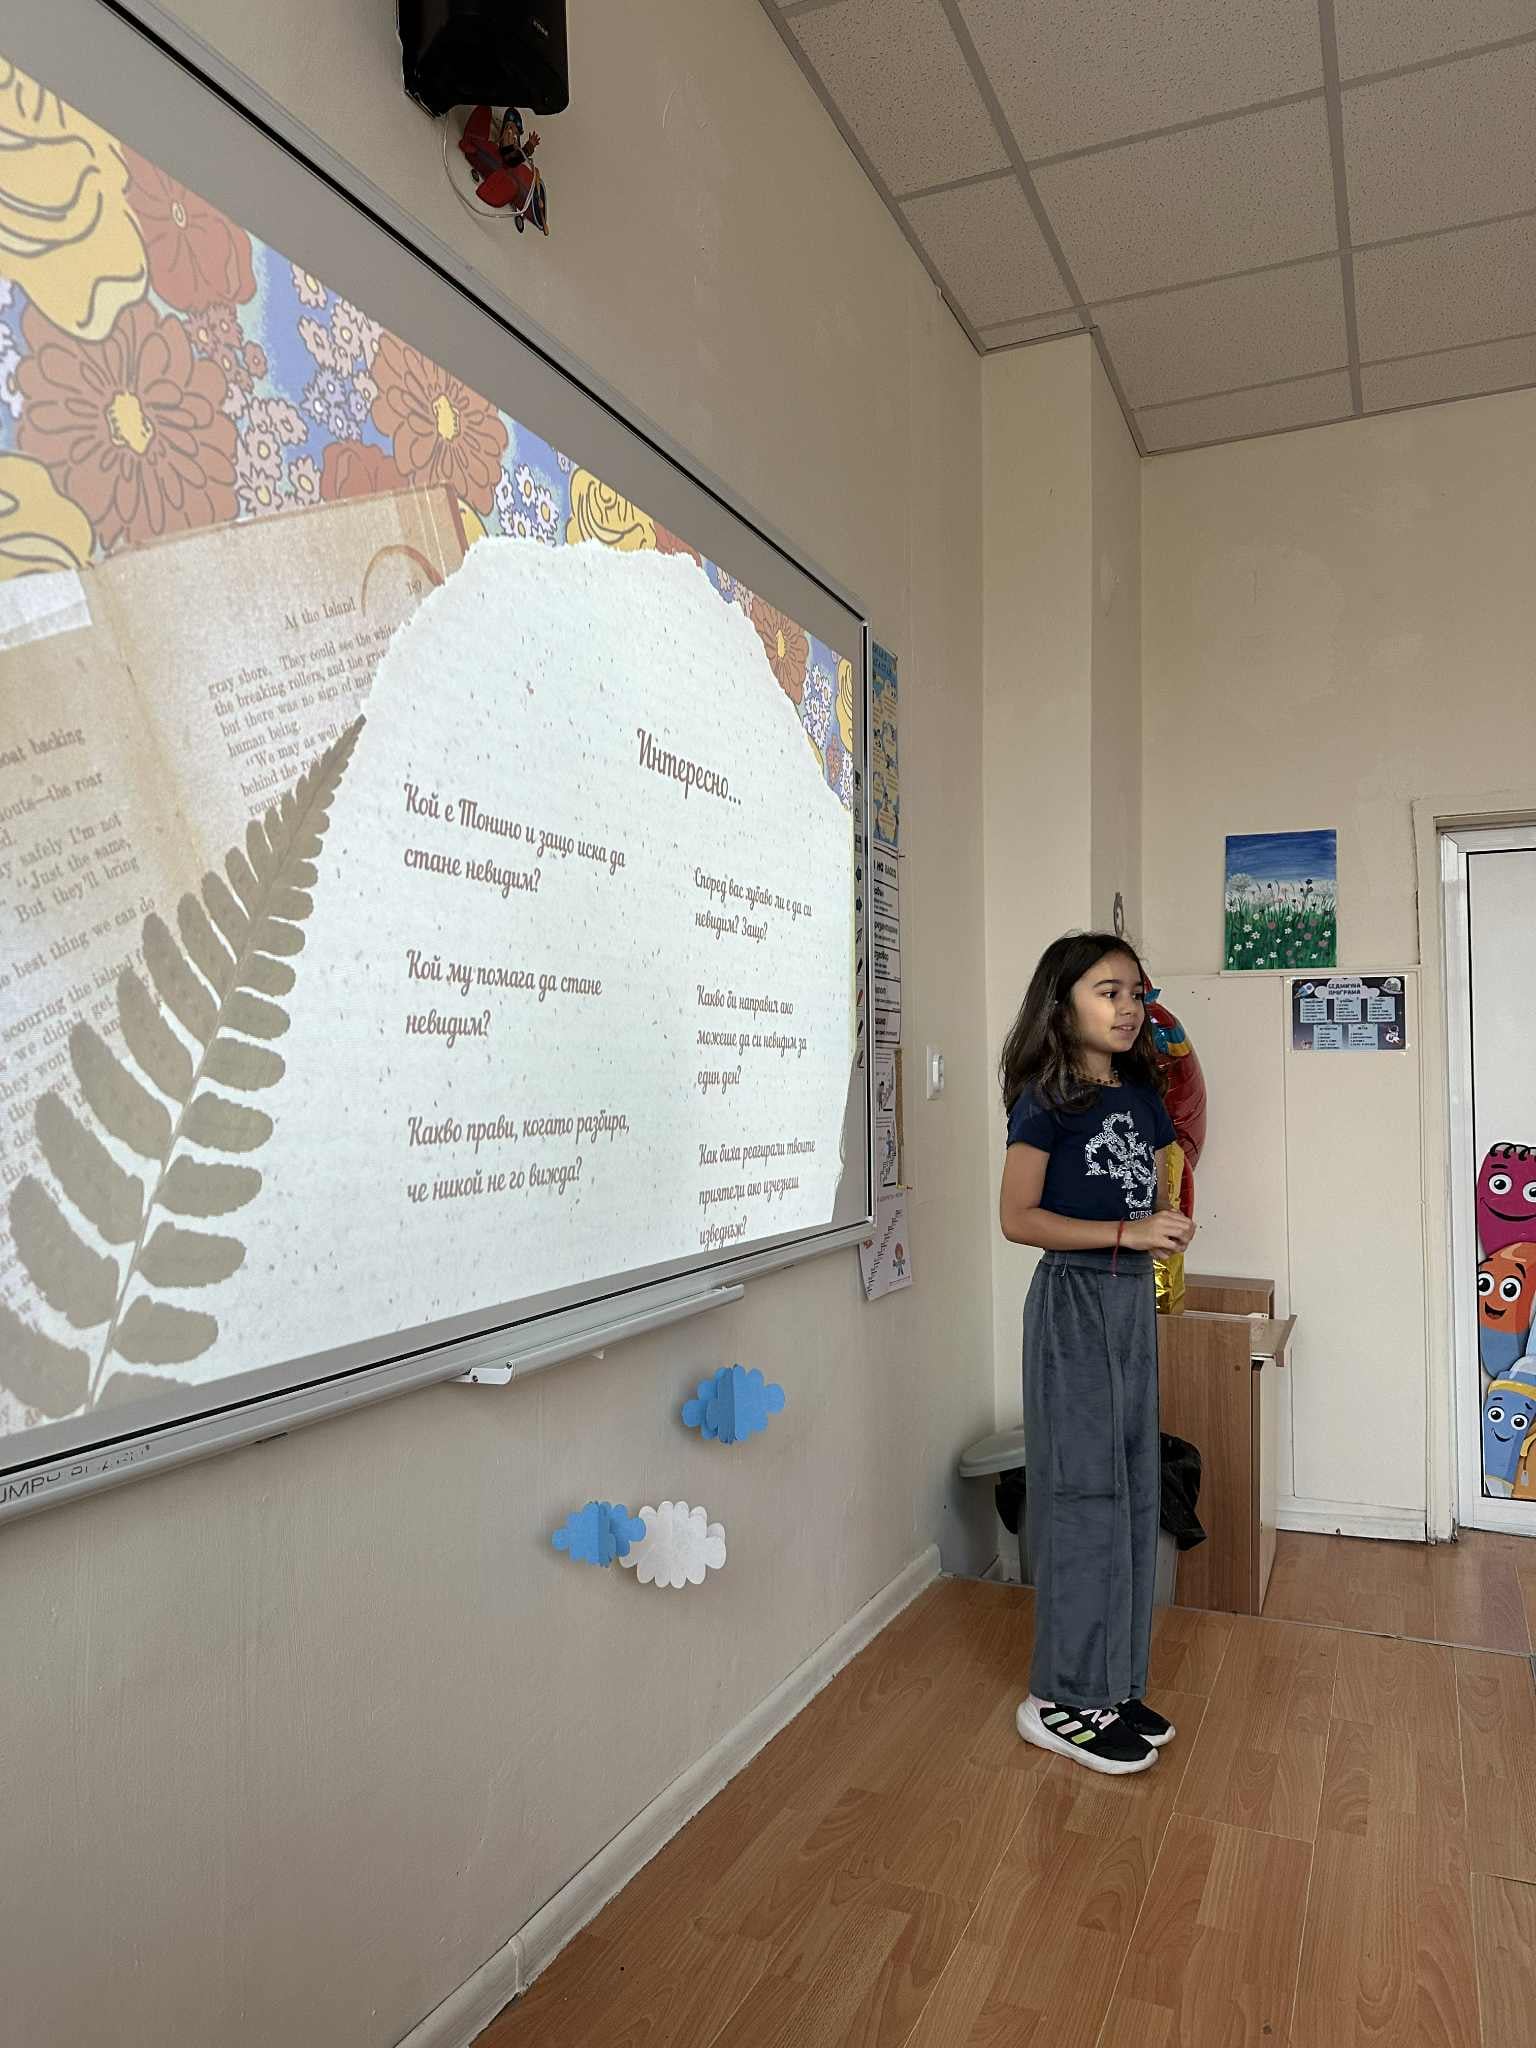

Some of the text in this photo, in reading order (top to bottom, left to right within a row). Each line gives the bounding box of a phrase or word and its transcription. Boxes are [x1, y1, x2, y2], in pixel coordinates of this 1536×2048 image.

[208, 679, 234, 699] gray
[279, 653, 306, 673] They
[310, 641, 336, 662] could
[214, 702, 234, 718] the
[236, 683, 287, 708] breaking
[327, 658, 345, 678] and
[220, 719, 241, 738] but
[244, 708, 274, 733] there
[317, 684, 339, 703] sign
[226, 734, 267, 759] human
[637, 727, 742, 805] Интересно...
[75, 772, 103, 793] roar
[239, 771, 279, 798] behind
[280, 764, 299, 780] the
[100, 811, 123, 832] not
[404, 782, 626, 876] Кой е Тонино и защо иска да
[67, 853, 90, 874] the
[404, 848, 542, 899] стане невидим?
[14, 898, 48, 925] But
[102, 856, 141, 880] bring
[694, 866, 813, 921] Според вас хубаво ли е да си
[12, 952, 48, 979] best
[50, 930, 90, 961] thing
[91, 920, 113, 938] we
[114, 908, 137, 926] can
[695, 910, 768, 944] невидим? Защо?
[406, 949, 603, 1002] Кой му помага да стане
[1, 994, 68, 1045] scouring
[67, 982, 92, 1003] the
[696, 984, 725, 1007] Какво
[726, 990, 738, 1009] би
[780, 1001, 794, 1015] ако
[405, 1008, 492, 1048] невидим?
[696, 1029, 807, 1059] можеше да си невидим за
[15, 1042, 37, 1061] we
[697, 1064, 742, 1095] един ден?
[408, 1109, 631, 1155] Какво прави, когато разбира,
[699, 1136, 816, 1170] Как биха реагирали твоите
[407, 1156, 583, 1203] че никой не го вижда?
[698, 1175, 800, 1215] приятели ако изчезнеш
[699, 1214, 748, 1253] изведнъж?
